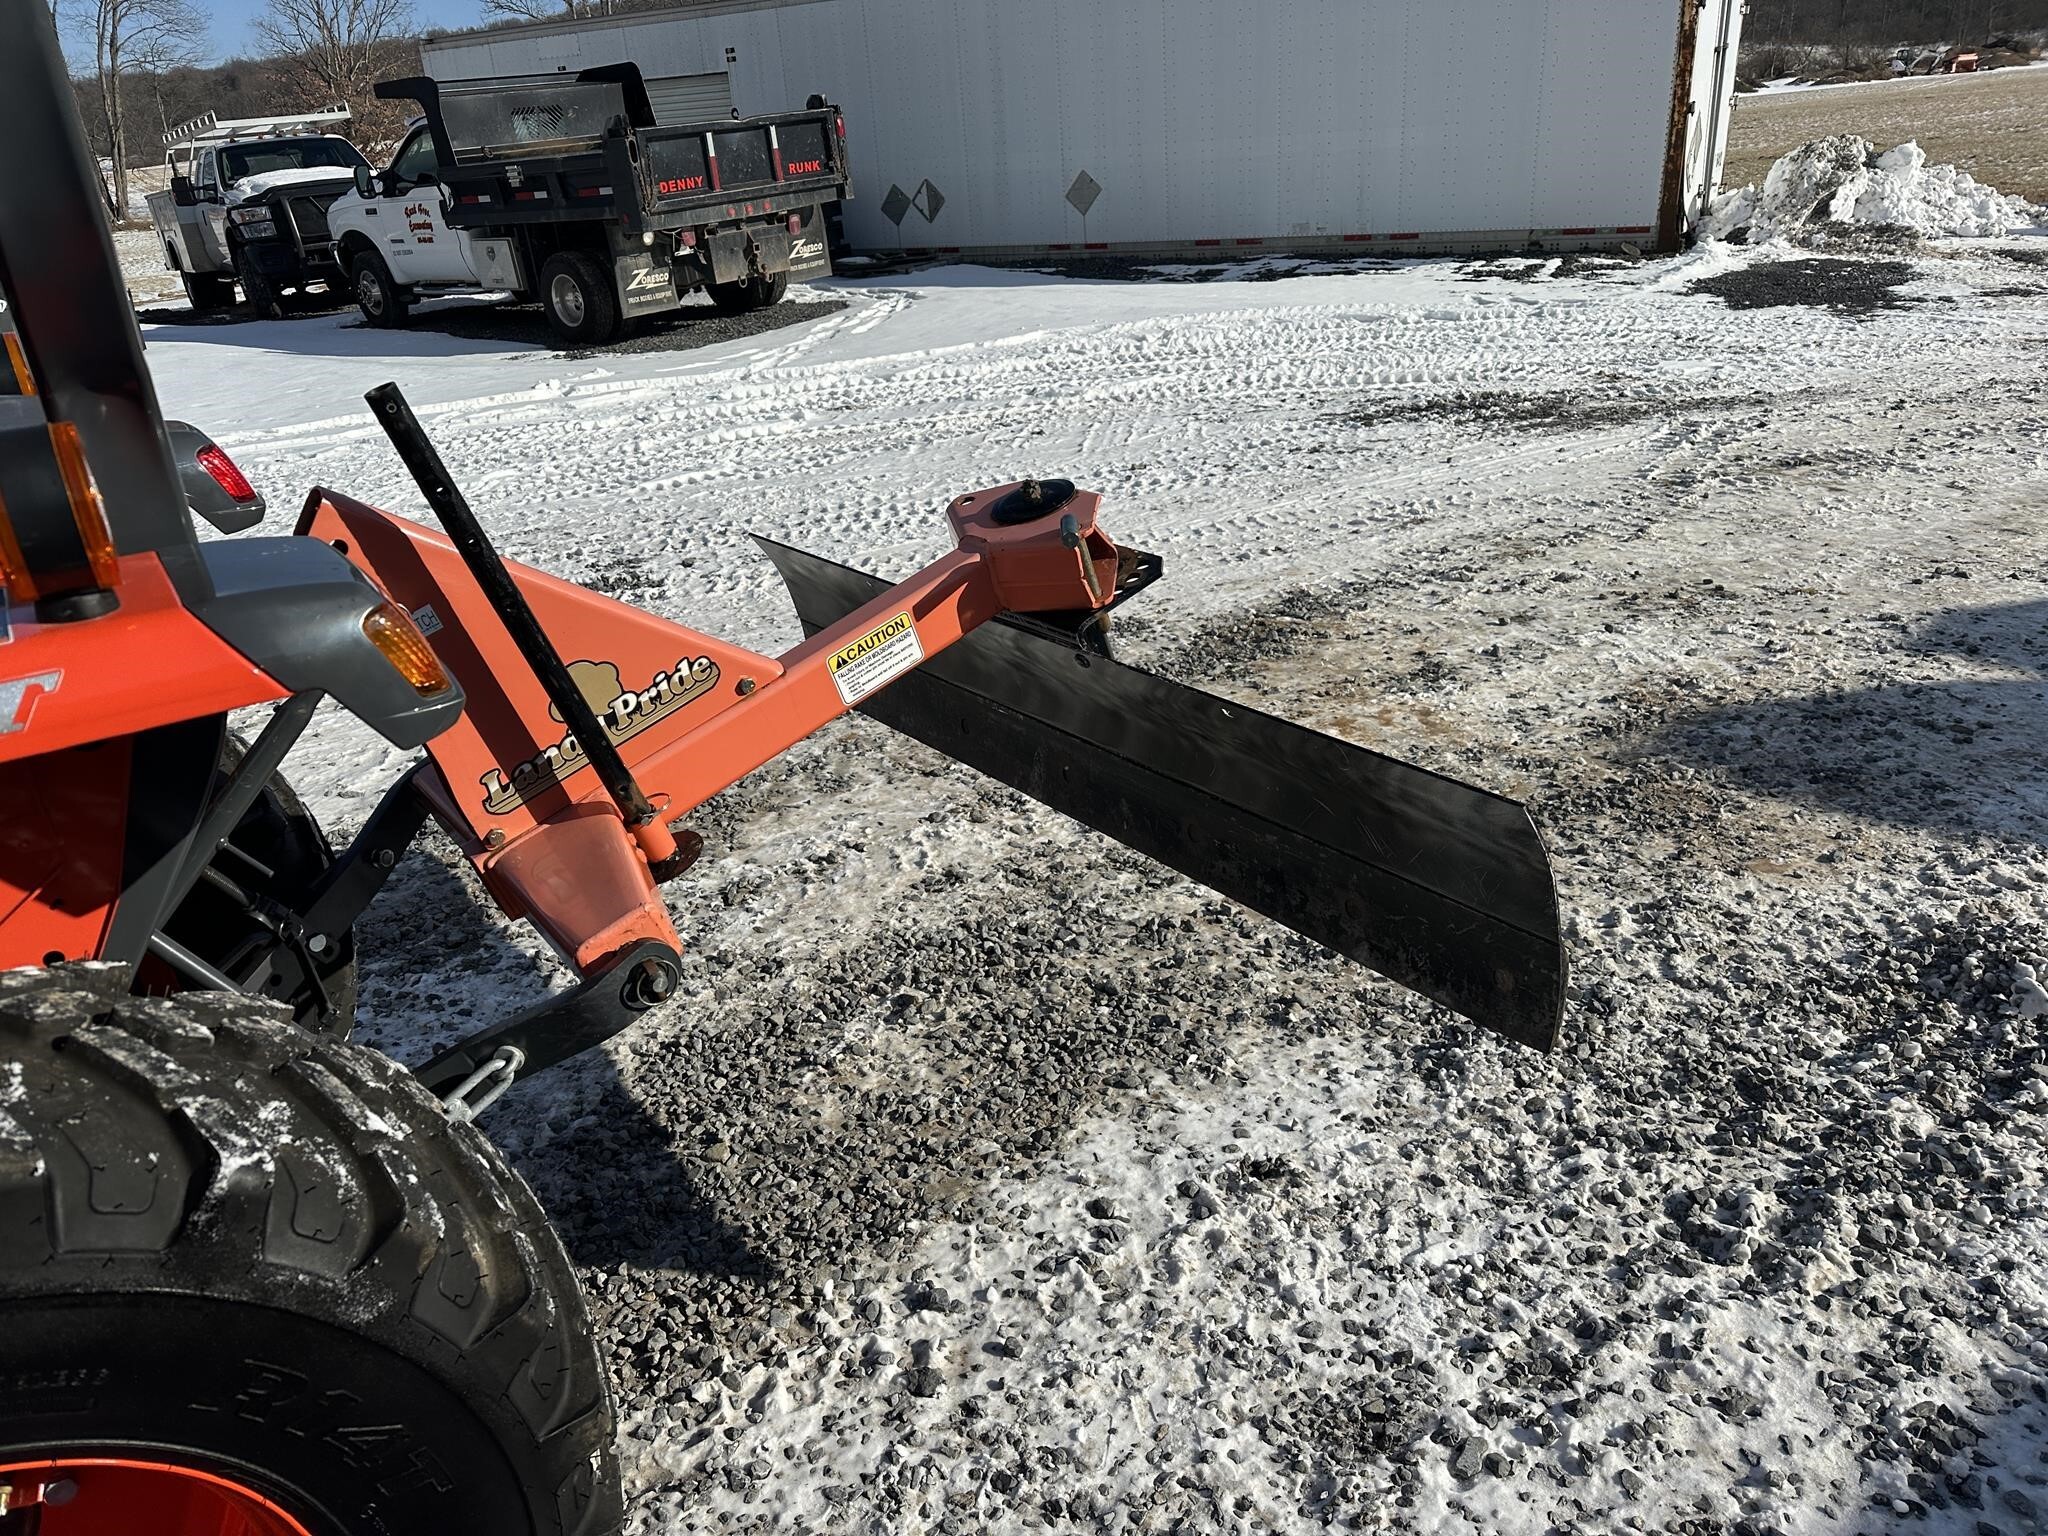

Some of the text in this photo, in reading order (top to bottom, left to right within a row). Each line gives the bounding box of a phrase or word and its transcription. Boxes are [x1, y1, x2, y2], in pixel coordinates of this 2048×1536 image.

[658, 160, 821, 194] DENNY RUNK
[837, 630, 912, 679] FALLING RAKE OR MOLDBOARD HAZARD
[846, 618, 906, 661] CAUTION
[608, 656, 715, 731] Pride
